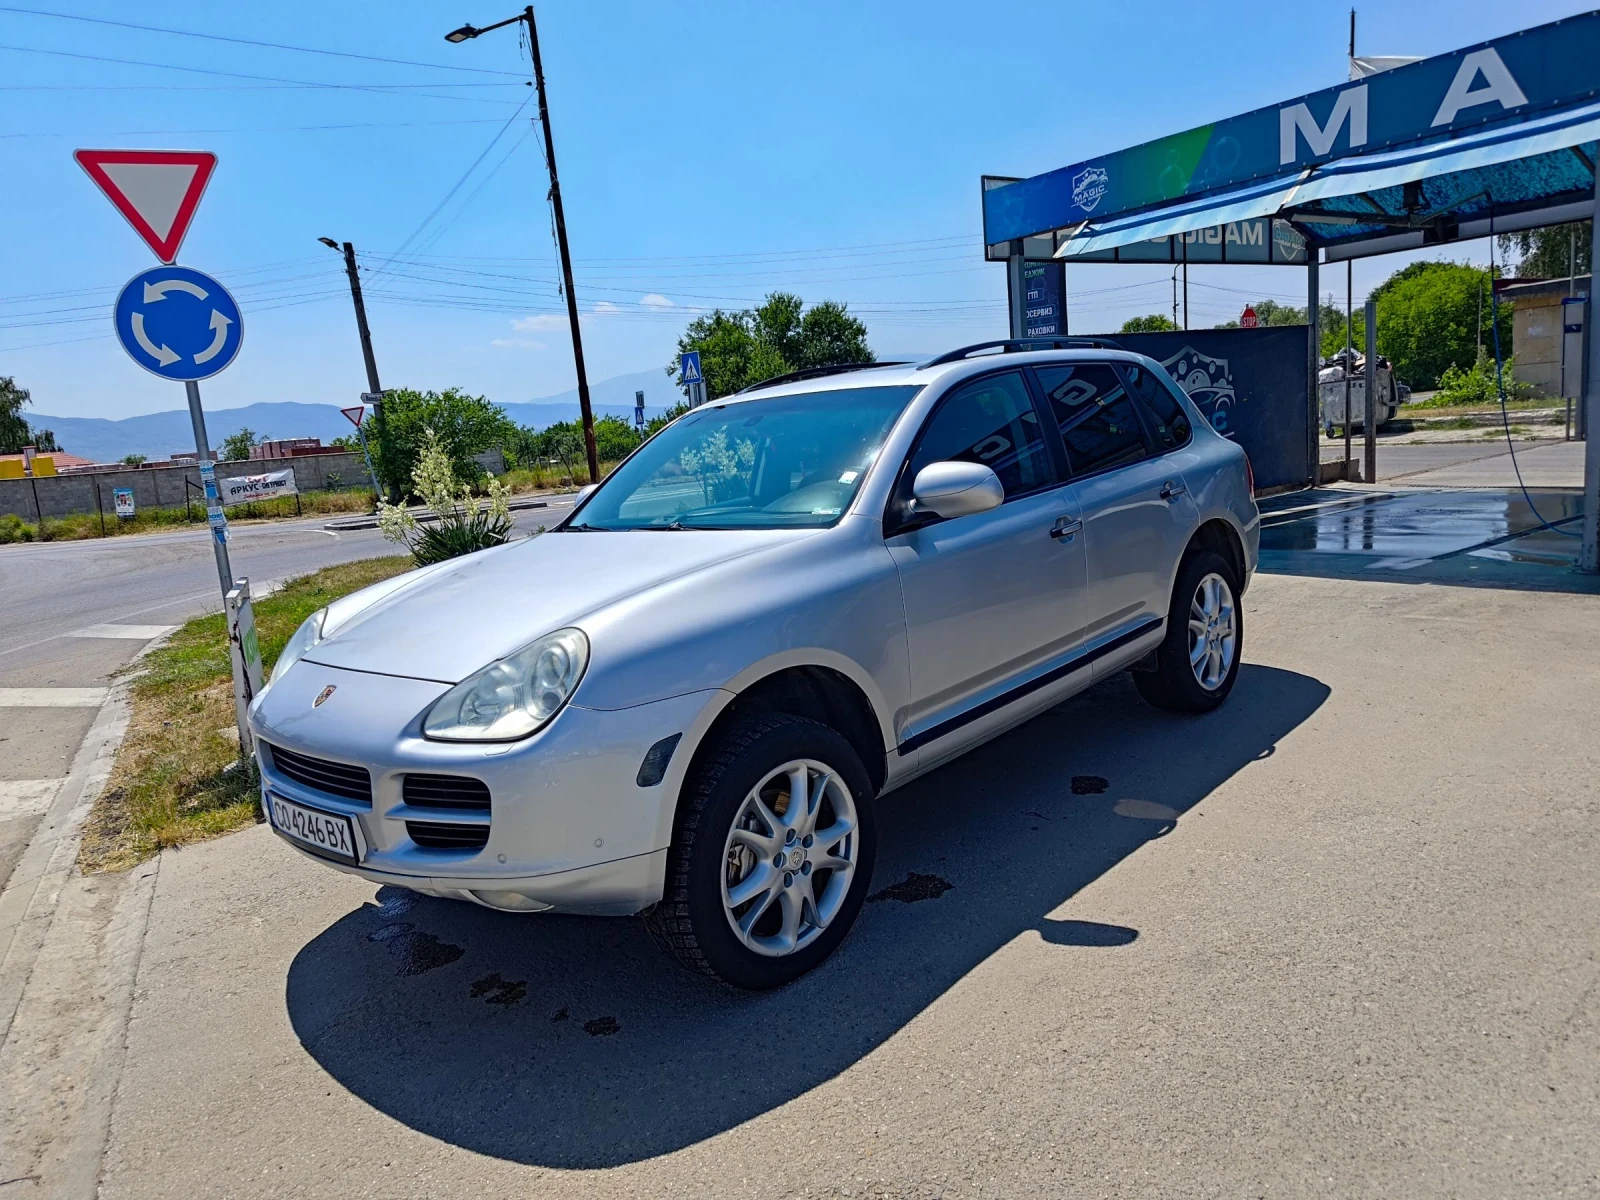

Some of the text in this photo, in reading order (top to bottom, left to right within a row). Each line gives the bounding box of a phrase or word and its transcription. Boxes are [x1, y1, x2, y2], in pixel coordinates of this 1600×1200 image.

[1074, 184, 1105, 203] MAGIC
[1243, 316, 1256, 327] STOP
[230, 483, 260, 496] АРКУС
